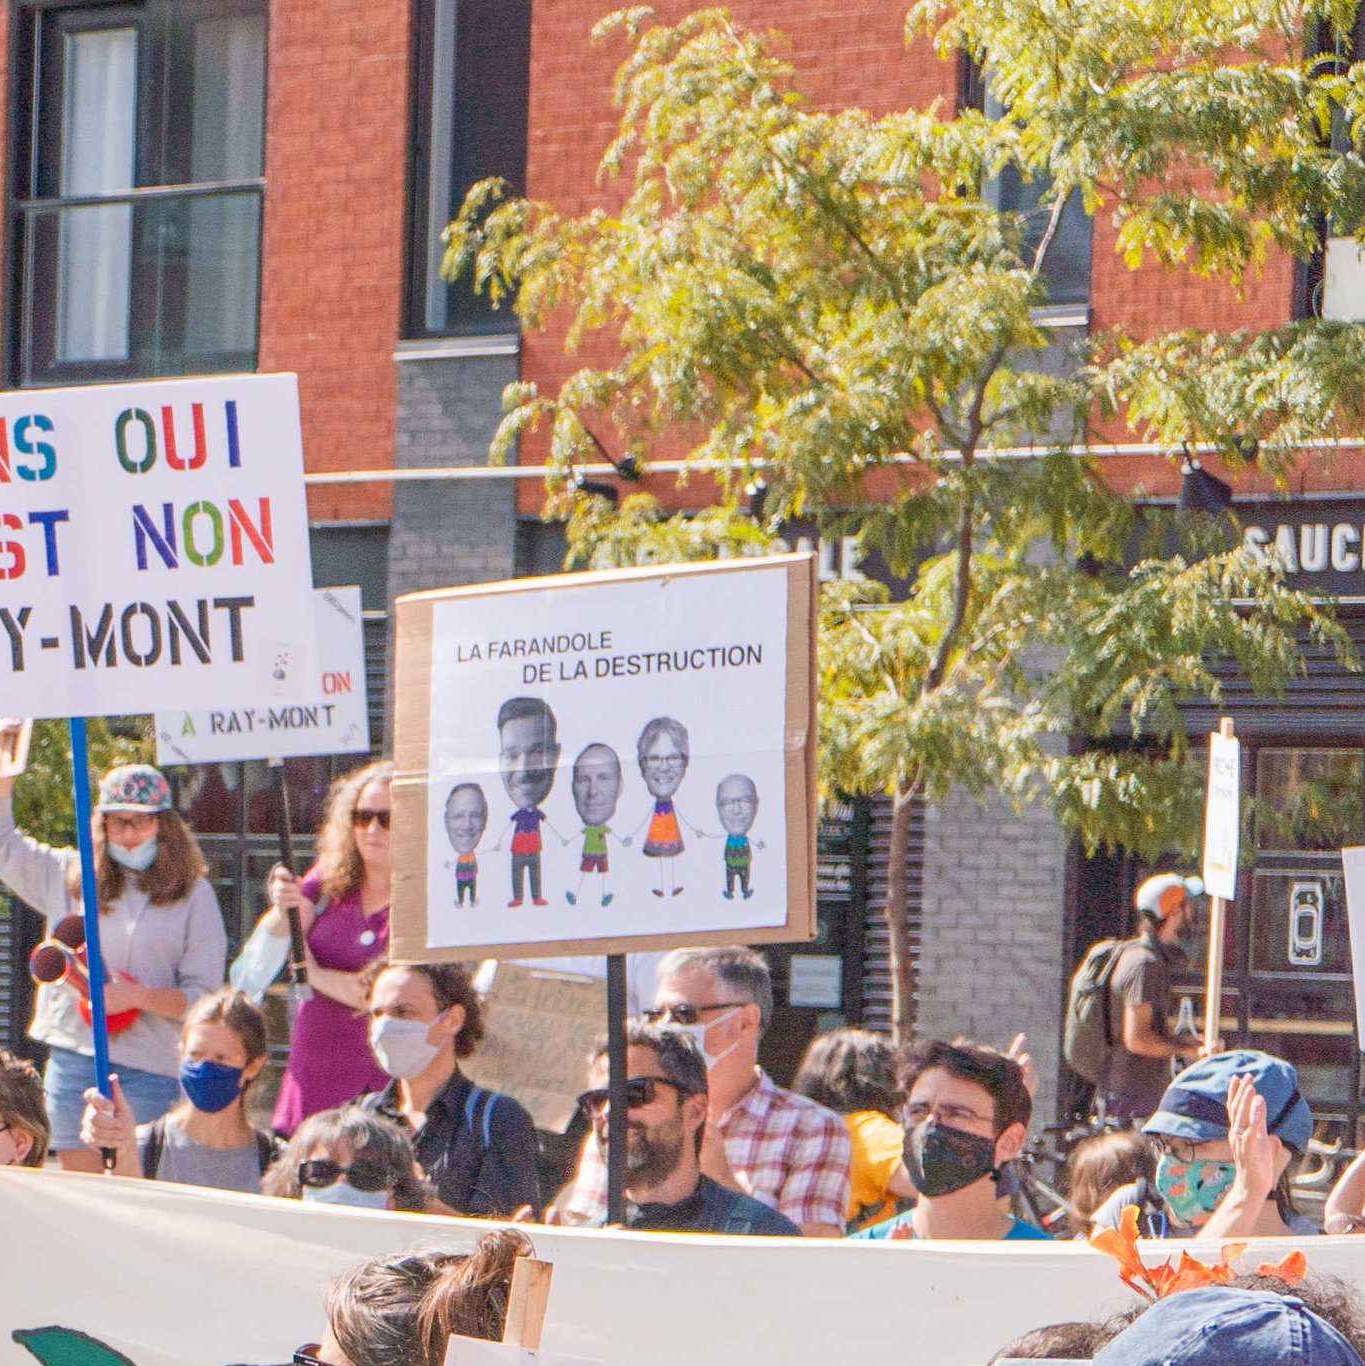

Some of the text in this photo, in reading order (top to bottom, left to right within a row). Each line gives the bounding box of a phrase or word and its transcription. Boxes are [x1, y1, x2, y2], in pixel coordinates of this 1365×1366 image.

[114, 400, 241, 474] OUI
[132, 497, 275, 572] NON
[1244, 522, 1365, 573] SAUC
[457, 631, 613, 663] LA FARANDOLE
[522, 644, 763, 685] DE LA DESTRUCTION
[322, 670, 352, 695] ON
[210, 705, 336, 734] RAY-MONT
